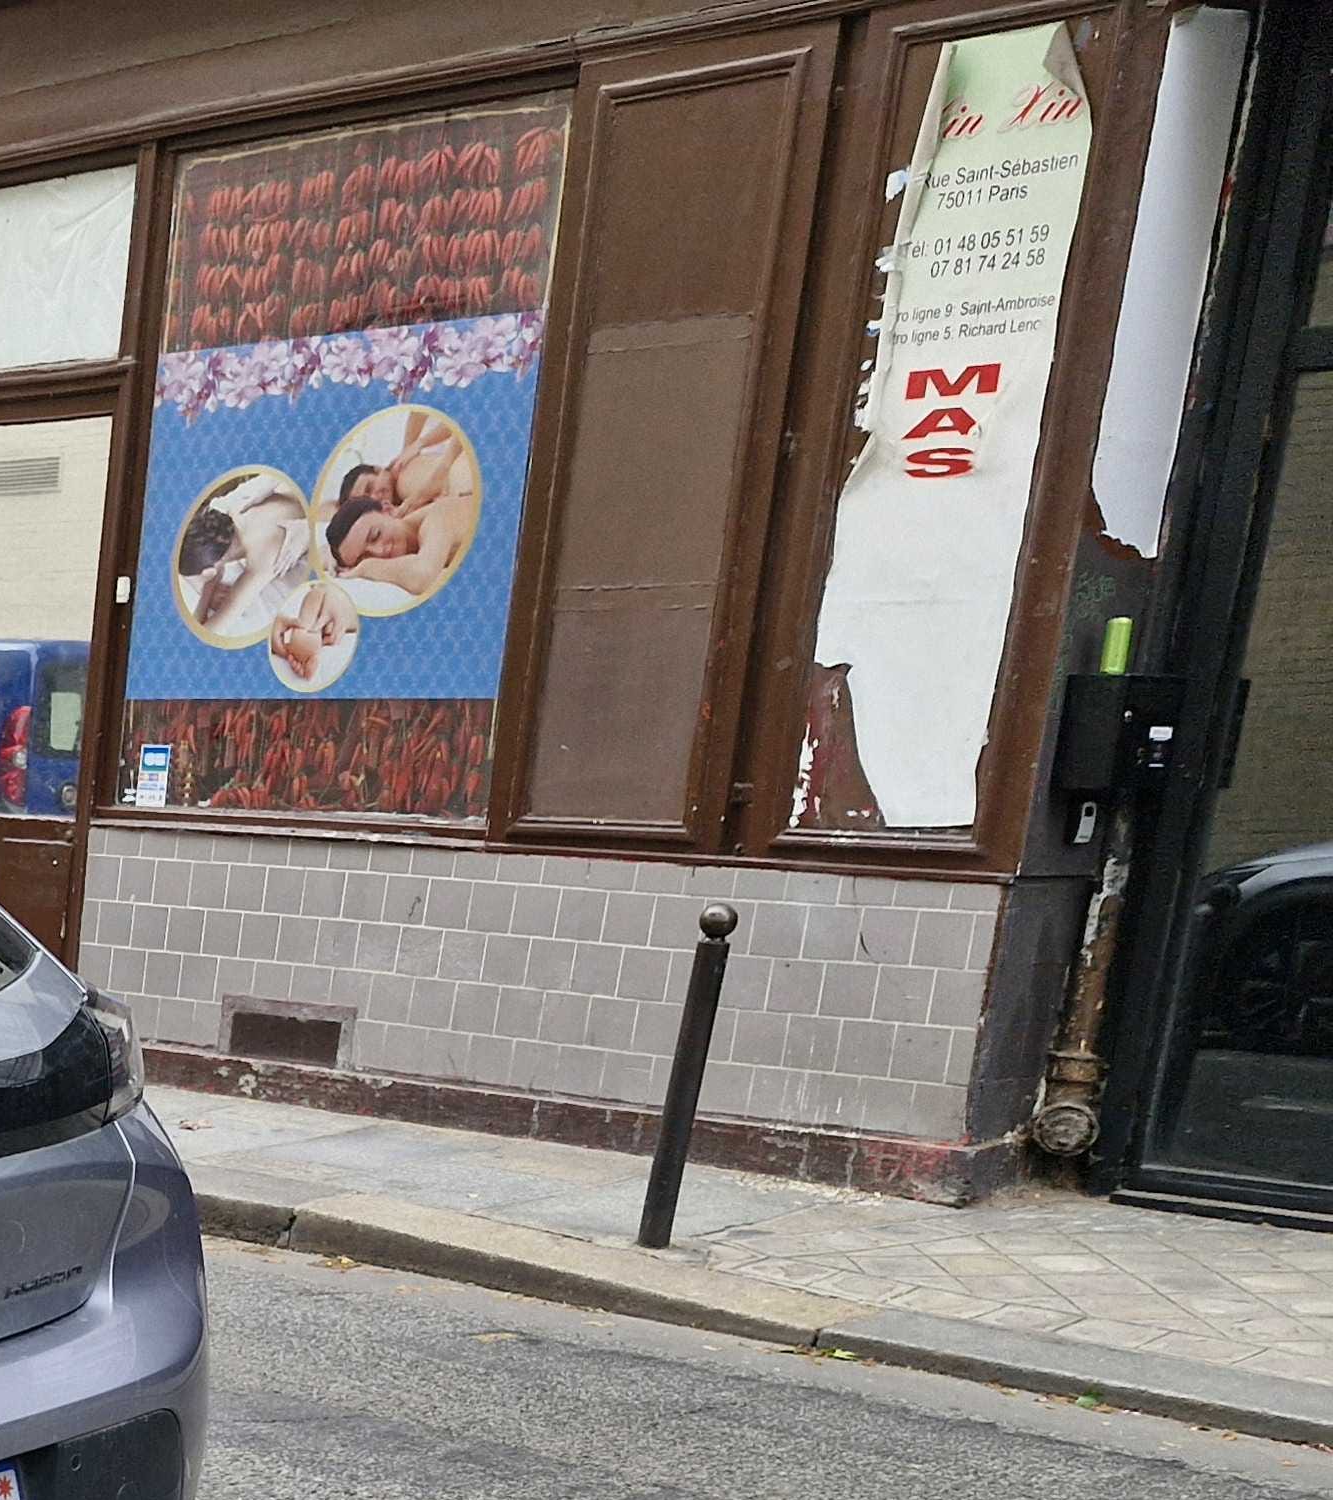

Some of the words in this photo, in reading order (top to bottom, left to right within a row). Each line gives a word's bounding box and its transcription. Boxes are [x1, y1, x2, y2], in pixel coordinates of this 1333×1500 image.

[955, 153, 1079, 185] Saint-Sébastien
[937, 189, 983, 210] 75011
[988, 184, 1029, 203] Paris
[934, 237, 952, 256] 01
[957, 234, 976, 252] 48
[981, 230, 1001, 250] 05
[1005, 228, 1023, 247] 51
[1030, 224, 1050, 243] 59
[930, 260, 950, 278] 07
[953, 257, 972, 276] 81
[978, 254, 997, 272] 74
[1001, 252, 1021, 270] 24
[1026, 248, 1045, 267] 58
[912, 307, 941, 323] ligne
[960, 294, 1055, 317] Saint-Ambroise
[911, 328, 940, 345] ligne
[958, 321, 1006, 338] Richard
[901, 363, 1001, 478] MAS
